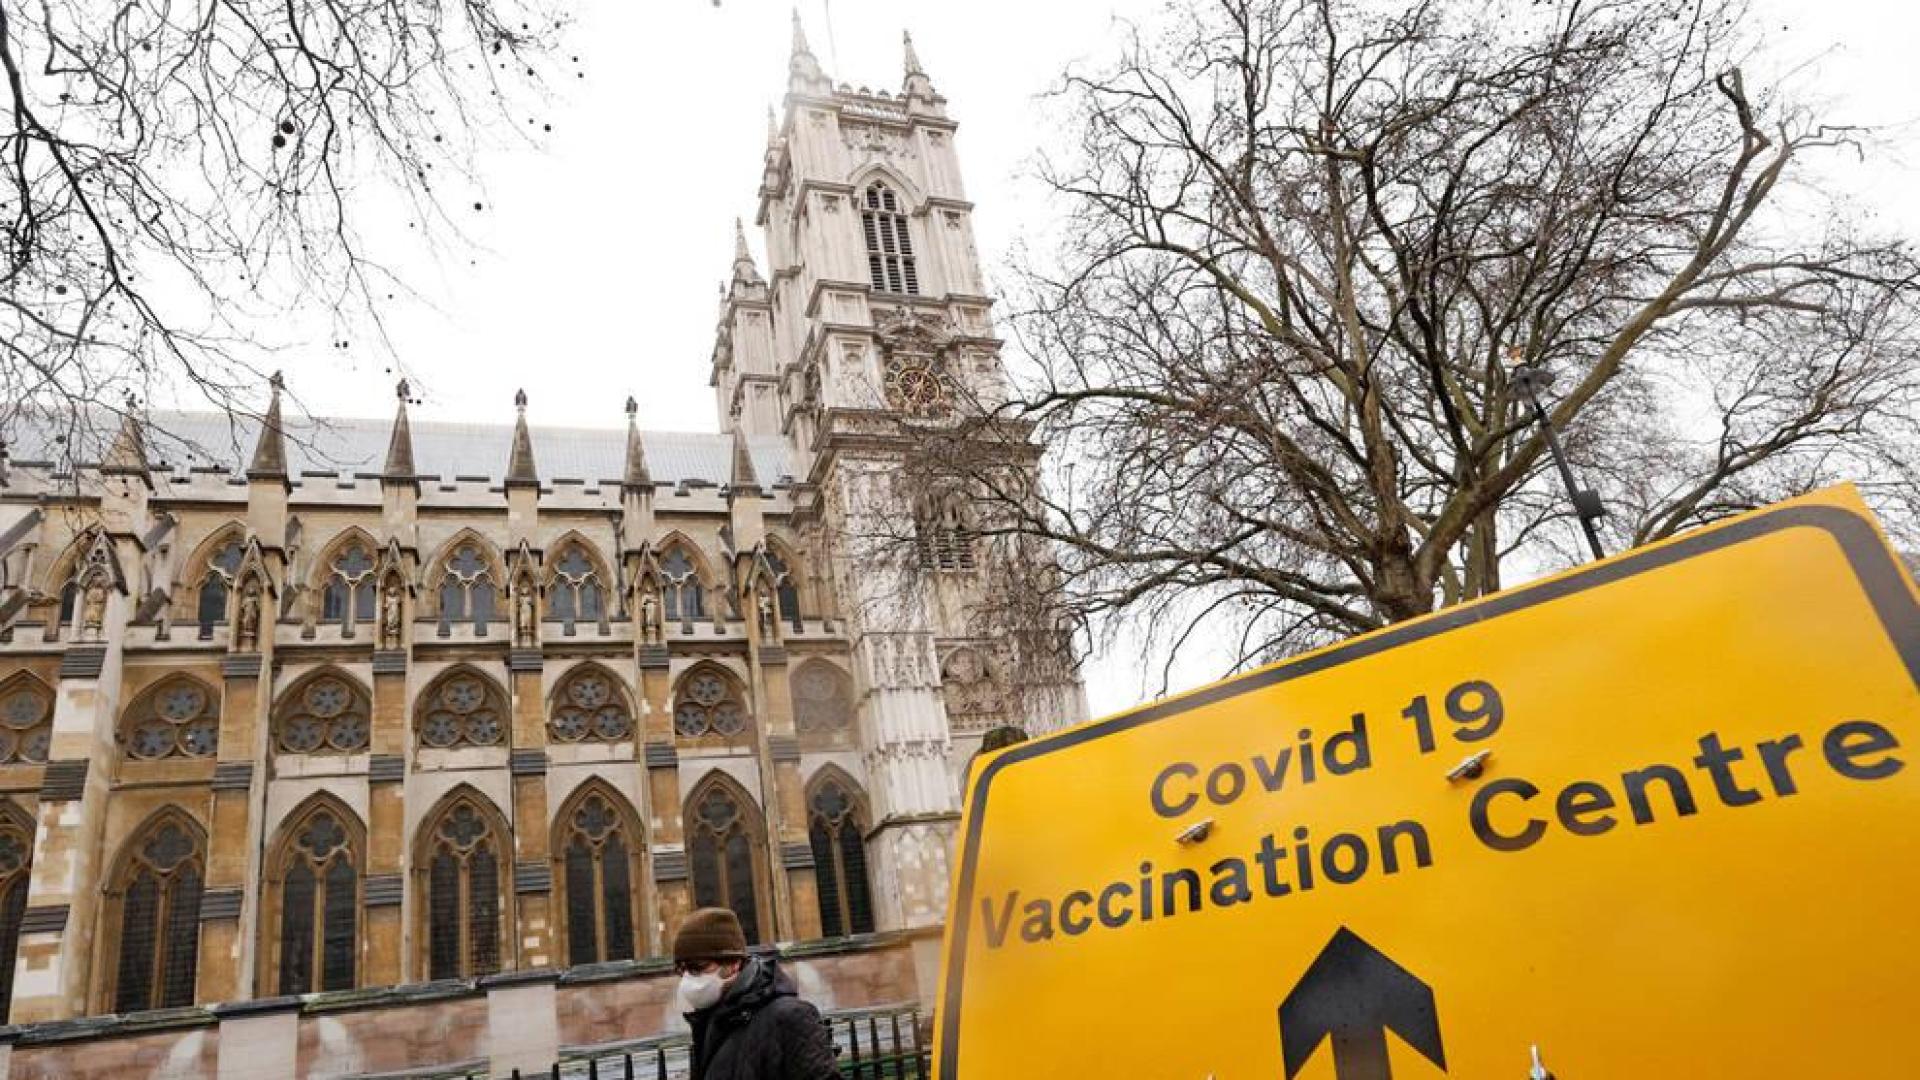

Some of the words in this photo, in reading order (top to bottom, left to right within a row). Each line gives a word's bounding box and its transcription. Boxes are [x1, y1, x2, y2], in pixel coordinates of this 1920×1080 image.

[979, 819, 1433, 949] Vaccination
[1469, 719, 1905, 852] Centre
[1150, 713, 1372, 819] Covid
[1401, 679, 1505, 754] 19
